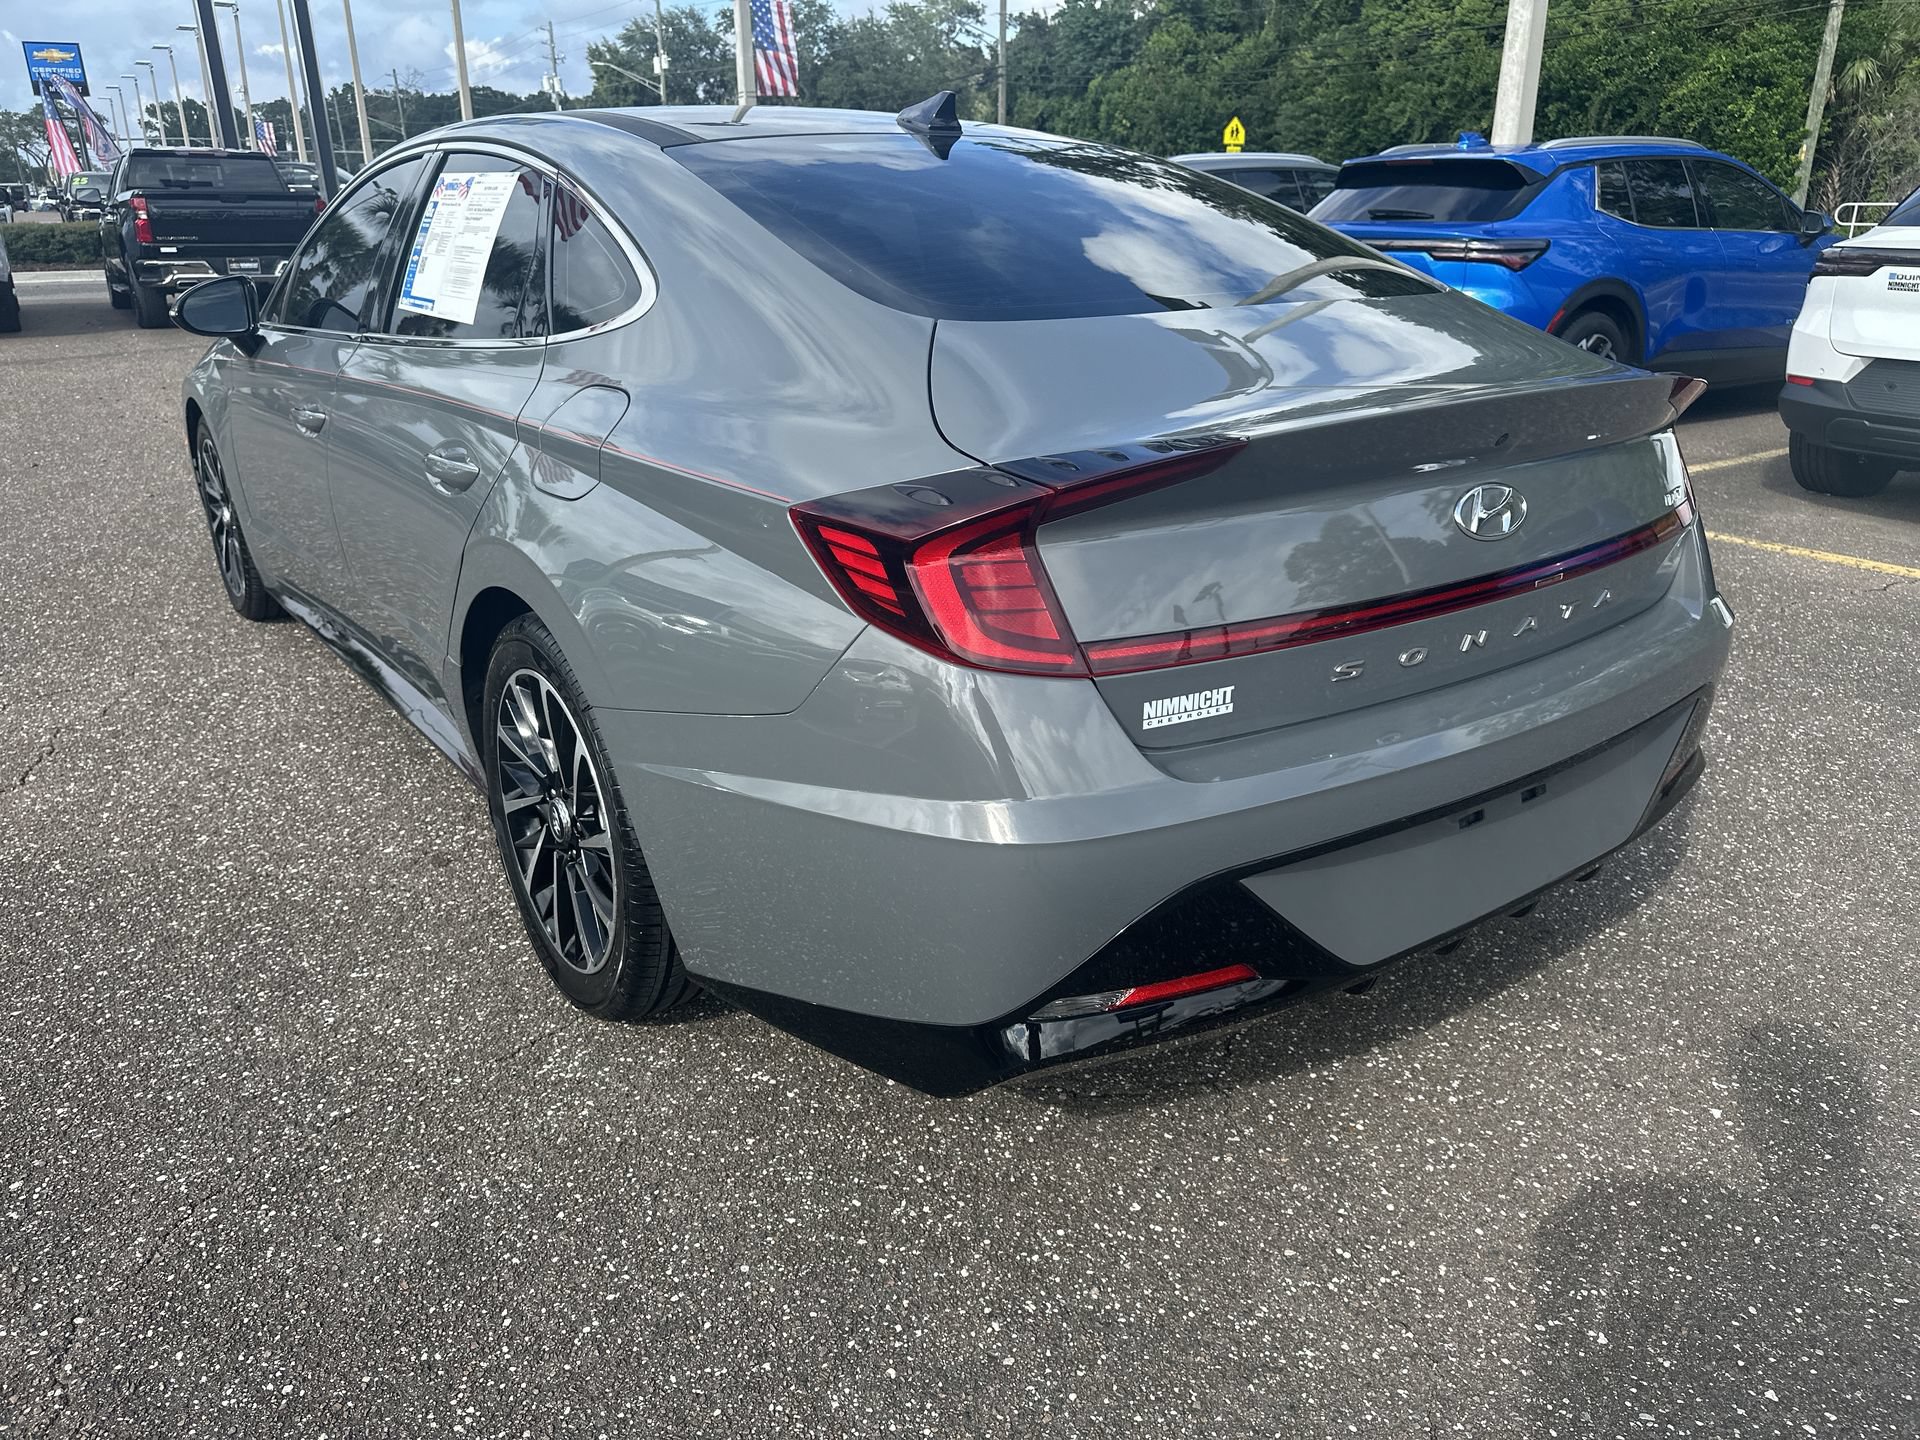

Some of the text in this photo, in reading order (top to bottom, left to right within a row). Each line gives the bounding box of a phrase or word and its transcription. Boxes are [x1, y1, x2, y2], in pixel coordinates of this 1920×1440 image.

[31, 66, 82, 74] CERTIFIED
[72, 177, 88, 185] 25
[1331, 589, 1611, 682] SONATA
[1143, 685, 1235, 719] NIMNICHT
[1146, 704, 1231, 727] CHEVROLET
